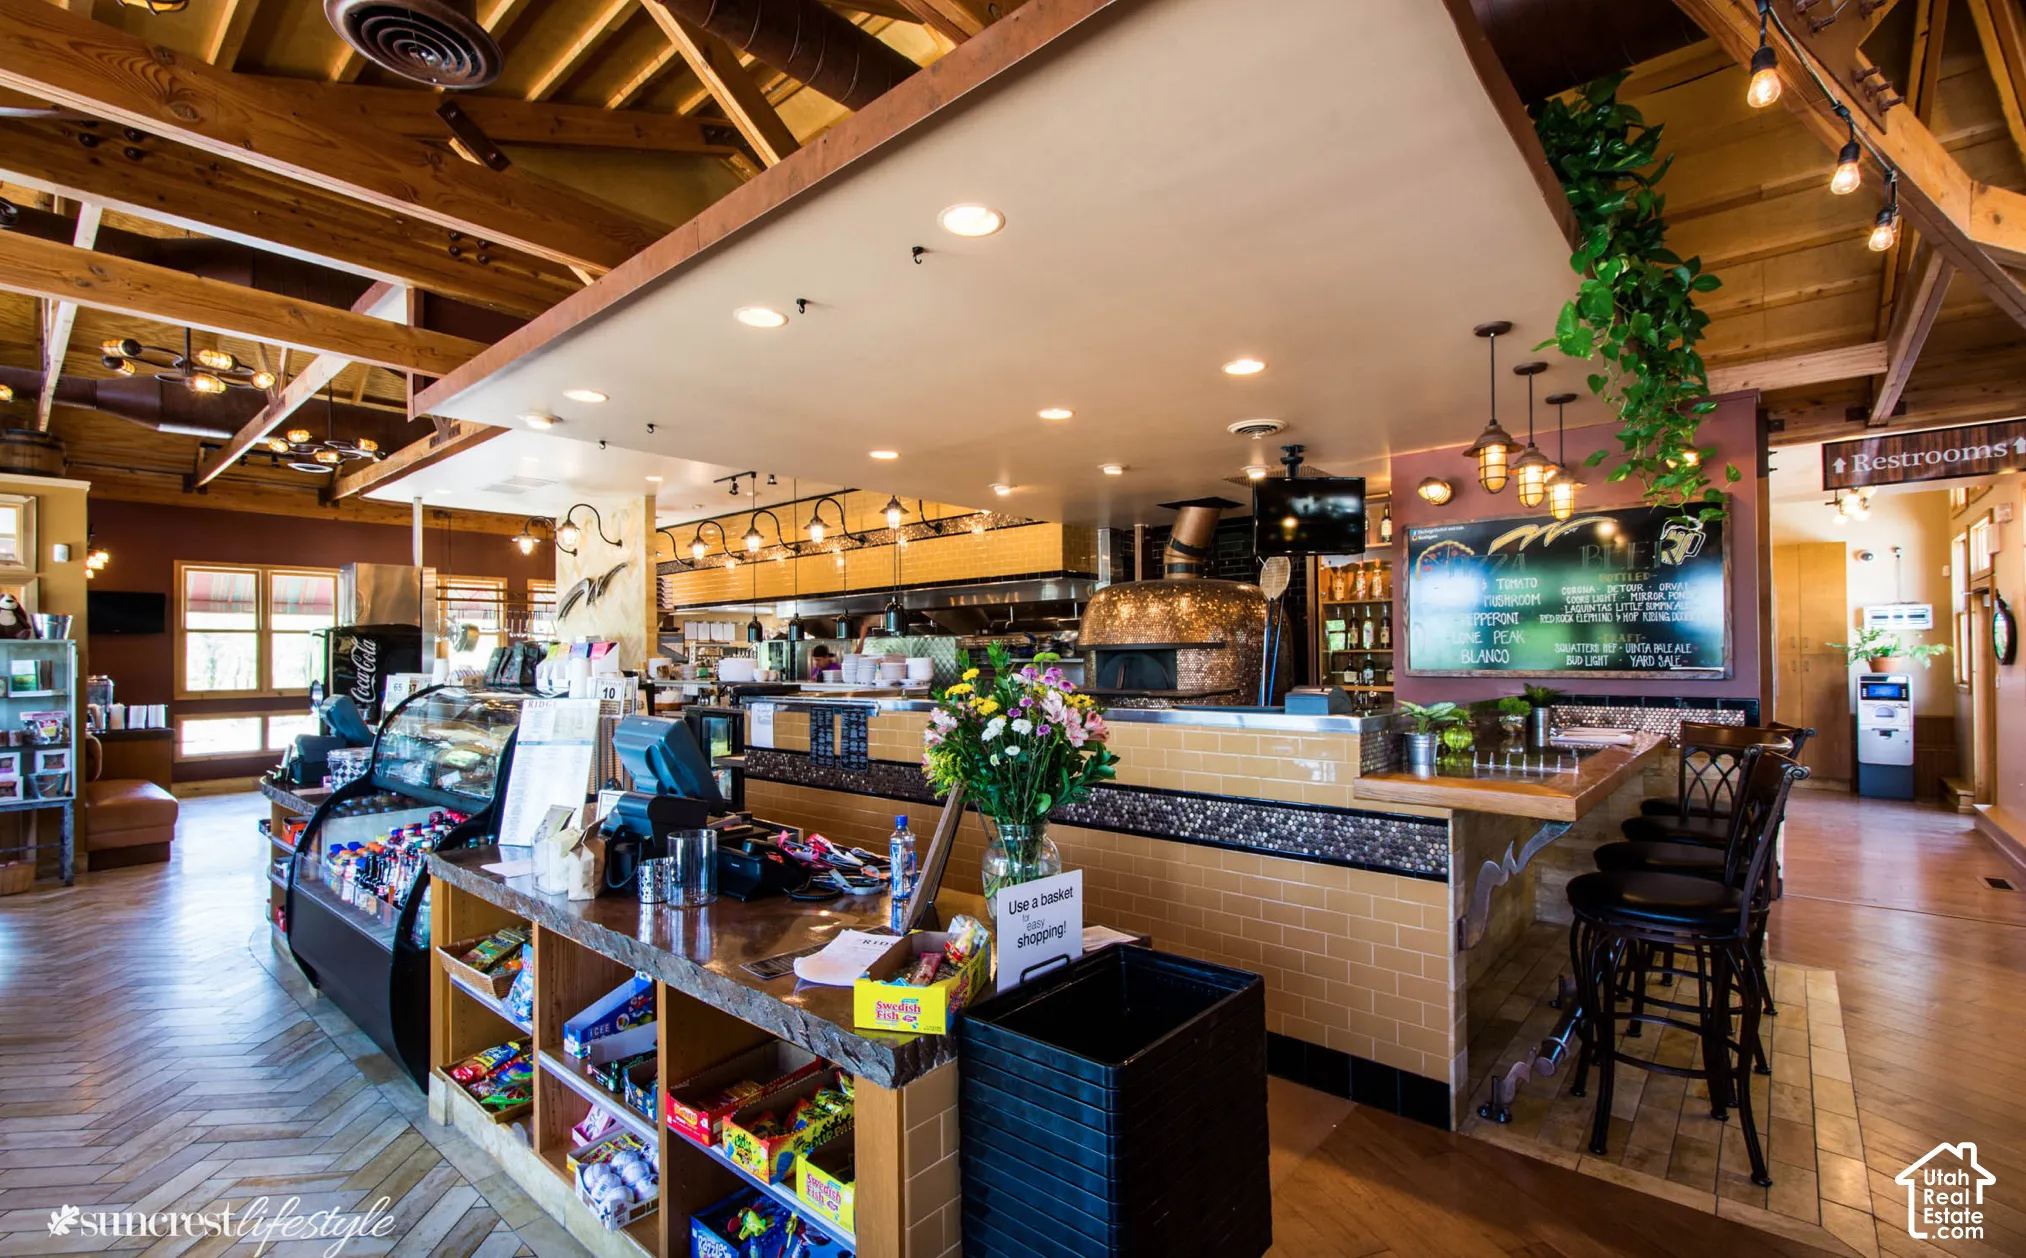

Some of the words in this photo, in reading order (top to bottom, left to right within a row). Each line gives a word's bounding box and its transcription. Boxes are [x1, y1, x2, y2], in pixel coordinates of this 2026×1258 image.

[1851, 442, 2008, 473] Restrooms
[1496, 577, 1538, 590] TOMATO
[1561, 585, 1596, 595] CORONA
[1607, 584, 1644, 593] DETOUR
[1483, 593, 1541, 607] MUSHROOM
[1566, 595, 1590, 604] COORS
[1592, 593, 1617, 603] LIGHT
[1630, 591, 1666, 601] MIRROR
[1615, 602, 1644, 612] LITTLE
[1540, 613, 1555, 623] RED
[1555, 613, 1574, 623] ROCK
[1623, 612, 1639, 623] HOP
[1493, 630, 1526, 645] PEAK
[1653, 643, 1673, 654] PALE
[1674, 643, 1692, 654] ALE
[1461, 648, 1510, 664] BLANCO
[1566, 655, 1583, 666] BUD
[1584, 655, 1609, 666] LIGHT
[1630, 655, 1655, 667] YARD
[1657, 655, 1682, 667] SALE
[602, 687, 616, 699] 10
[1008, 899, 1030, 915] Use
[1031, 897, 1039, 909] a
[1040, 886, 1074, 906] basket
[1022, 914, 1030, 922] for
[1026, 918, 1046, 932] easy
[1017, 920, 1067, 949] shopping!
[862, 938, 895, 947] RID
[876, 1000, 921, 1014] Swedish
[876, 1010, 899, 1021] Fish
[806, 1172, 842, 1205] Swedish
[806, 1184, 825, 1206] Fish
